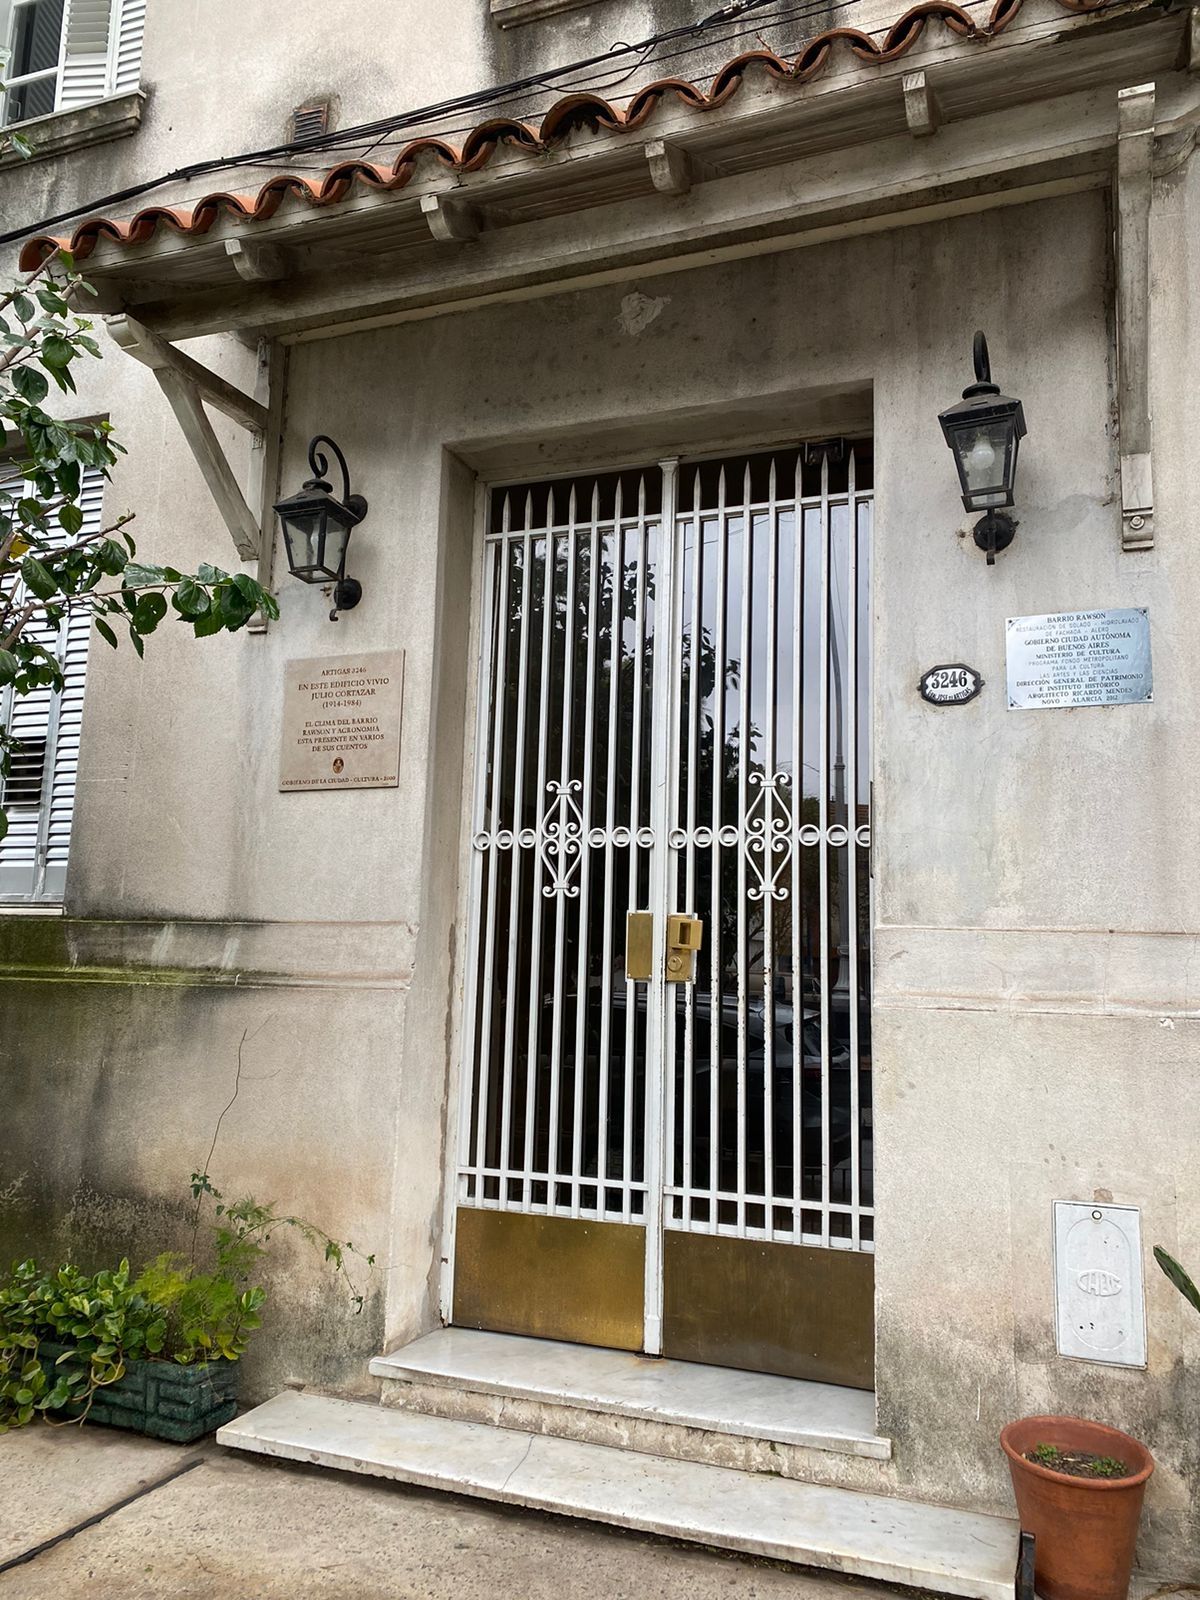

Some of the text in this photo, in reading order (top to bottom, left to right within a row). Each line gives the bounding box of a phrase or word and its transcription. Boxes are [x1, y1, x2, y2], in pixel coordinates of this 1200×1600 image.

[1091, 632, 1131, 640] AUTÓNOMA
[321, 668, 350, 676] ARTIGAS
[330, 680, 365, 688] EDIFICIO
[932, 671, 967, 689] 3246
[311, 689, 376, 700] JULIO CORTAZAR
[322, 700, 362, 709] (1914-1984)
